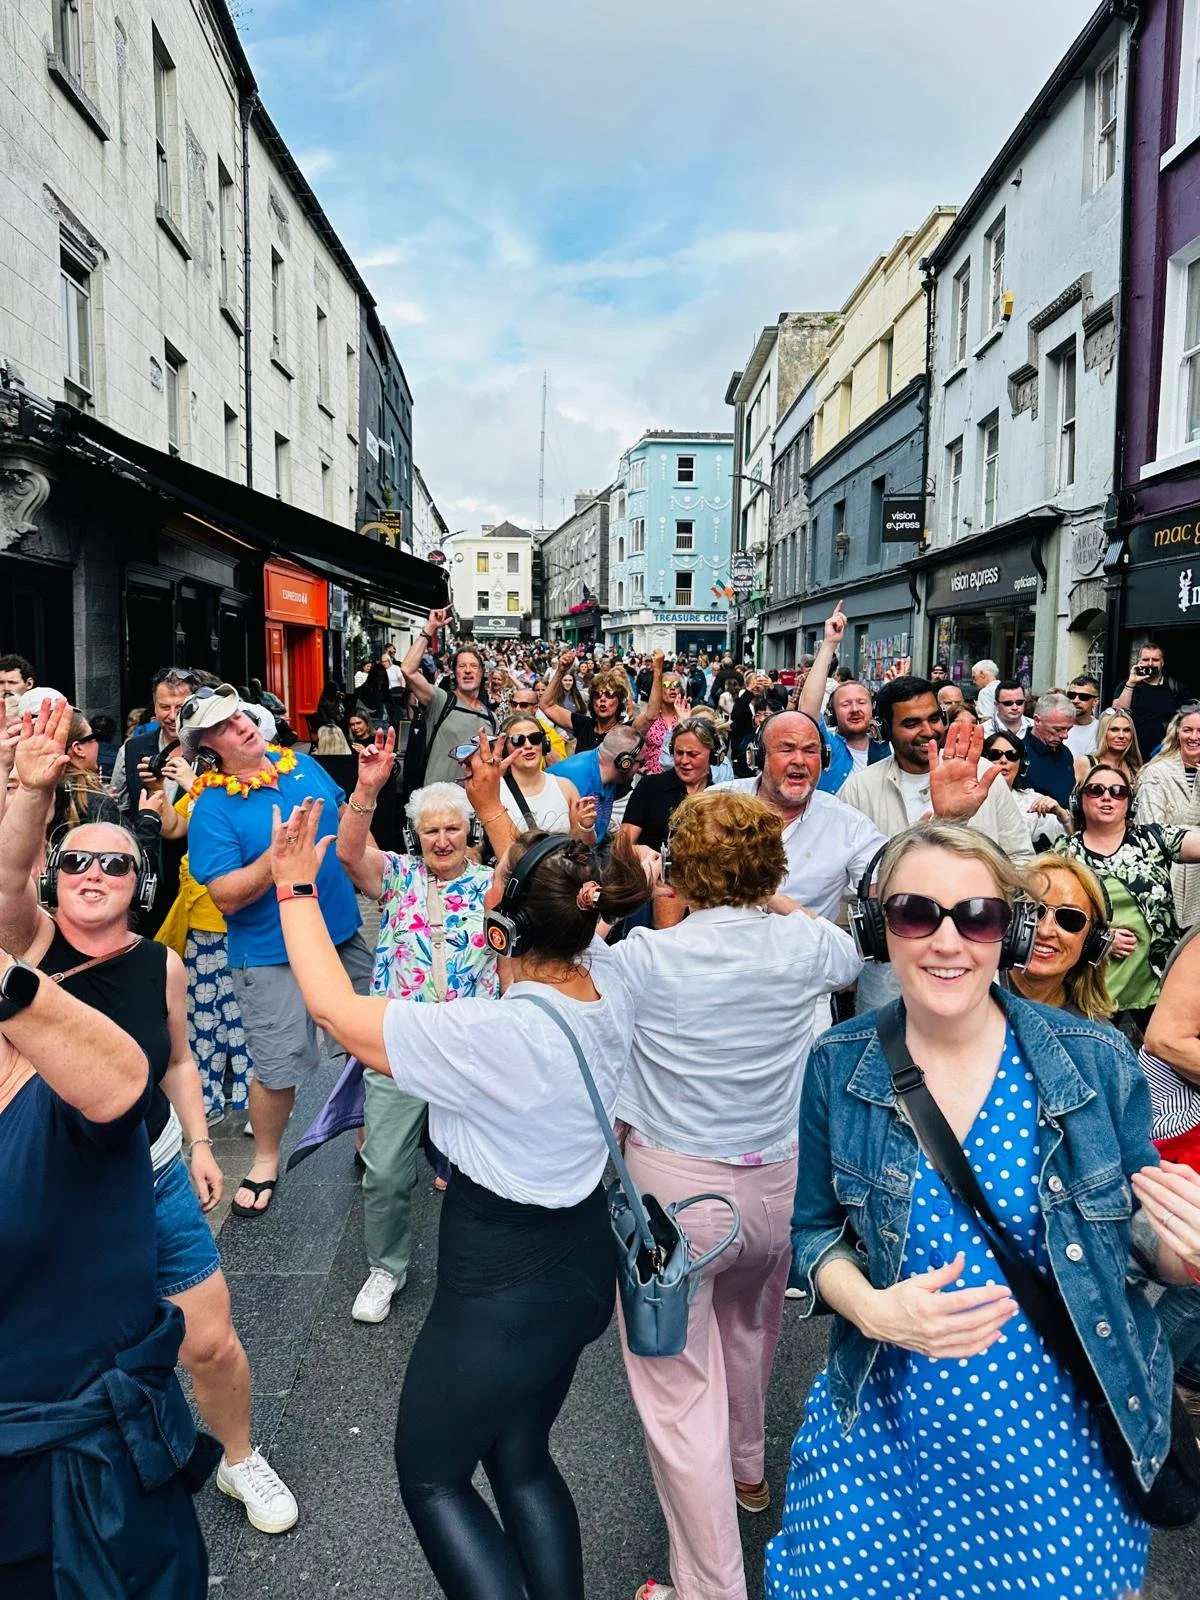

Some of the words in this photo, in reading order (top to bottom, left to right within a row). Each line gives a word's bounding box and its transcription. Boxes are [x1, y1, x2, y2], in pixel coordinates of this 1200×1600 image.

[891, 511, 916, 520] vision
[886, 521, 920, 531] express
[1076, 531, 1098, 550] ARCH
[1154, 524, 1191, 547] mac
[951, 572, 969, 592] vision
[969, 566, 999, 591] express
[1014, 574, 1037, 591] opticians
[655, 614, 700, 622] TREASURE
